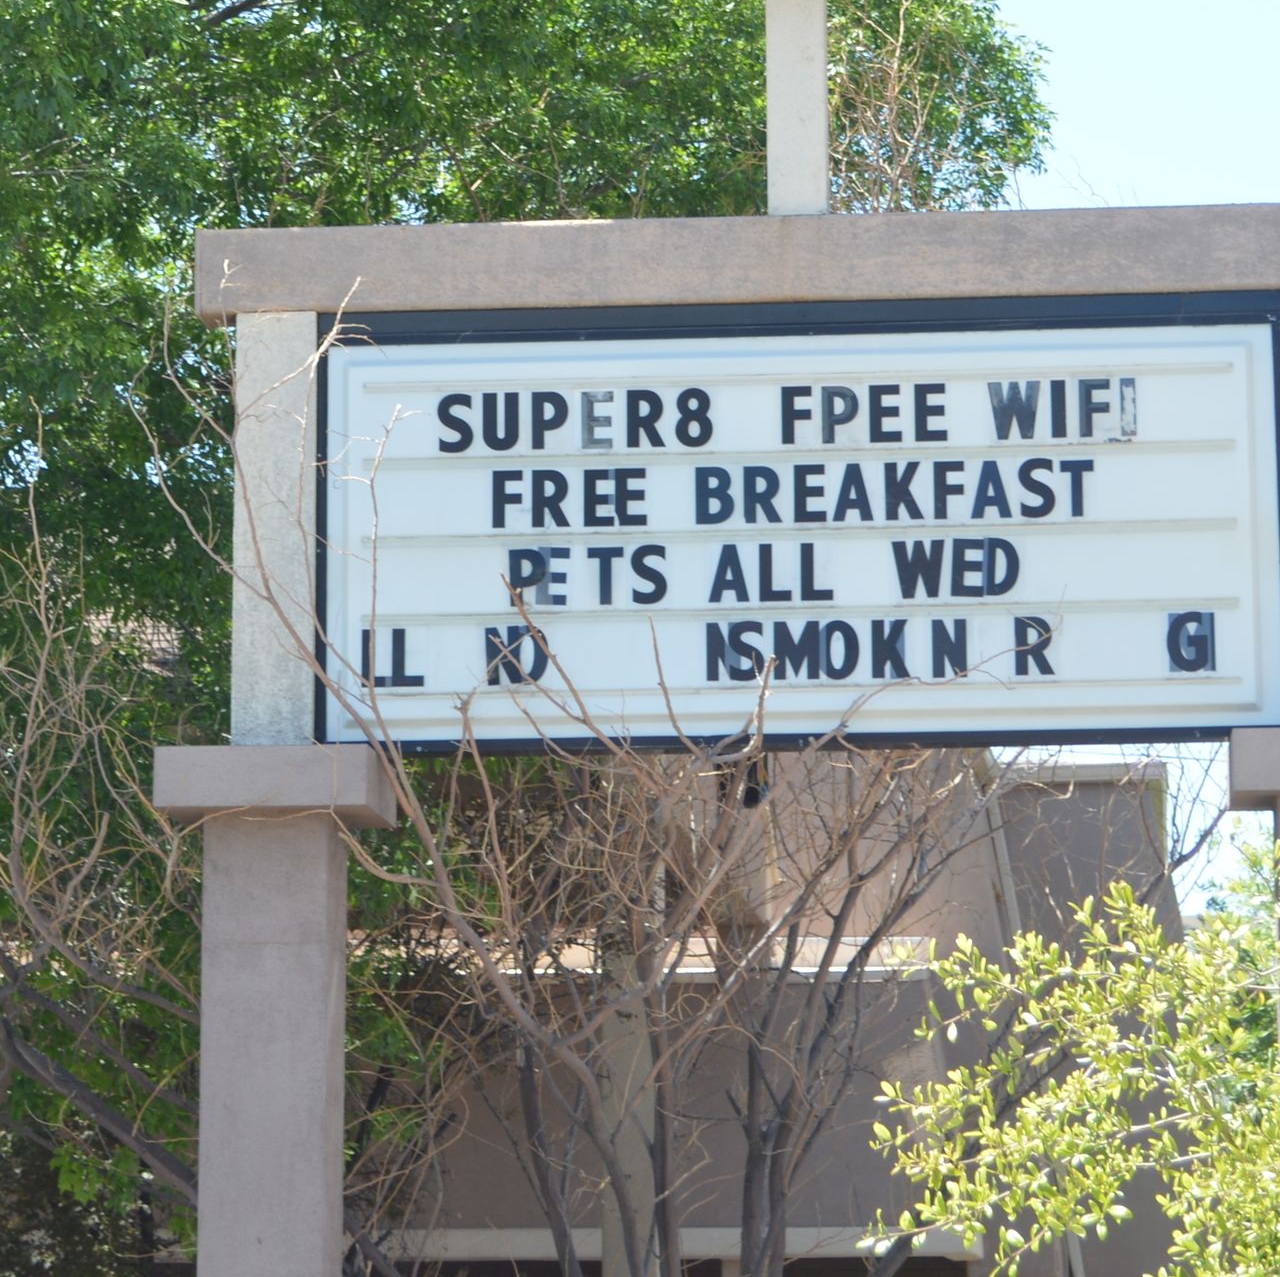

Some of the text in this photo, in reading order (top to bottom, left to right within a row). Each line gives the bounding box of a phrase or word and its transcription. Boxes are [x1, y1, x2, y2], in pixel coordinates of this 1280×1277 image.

[436, 387, 714, 454] SUPER8
[780, 382, 949, 445] FPEE
[491, 458, 1095, 529] FREE BREAKFAST
[508, 536, 1020, 608] PETS ALL WED
